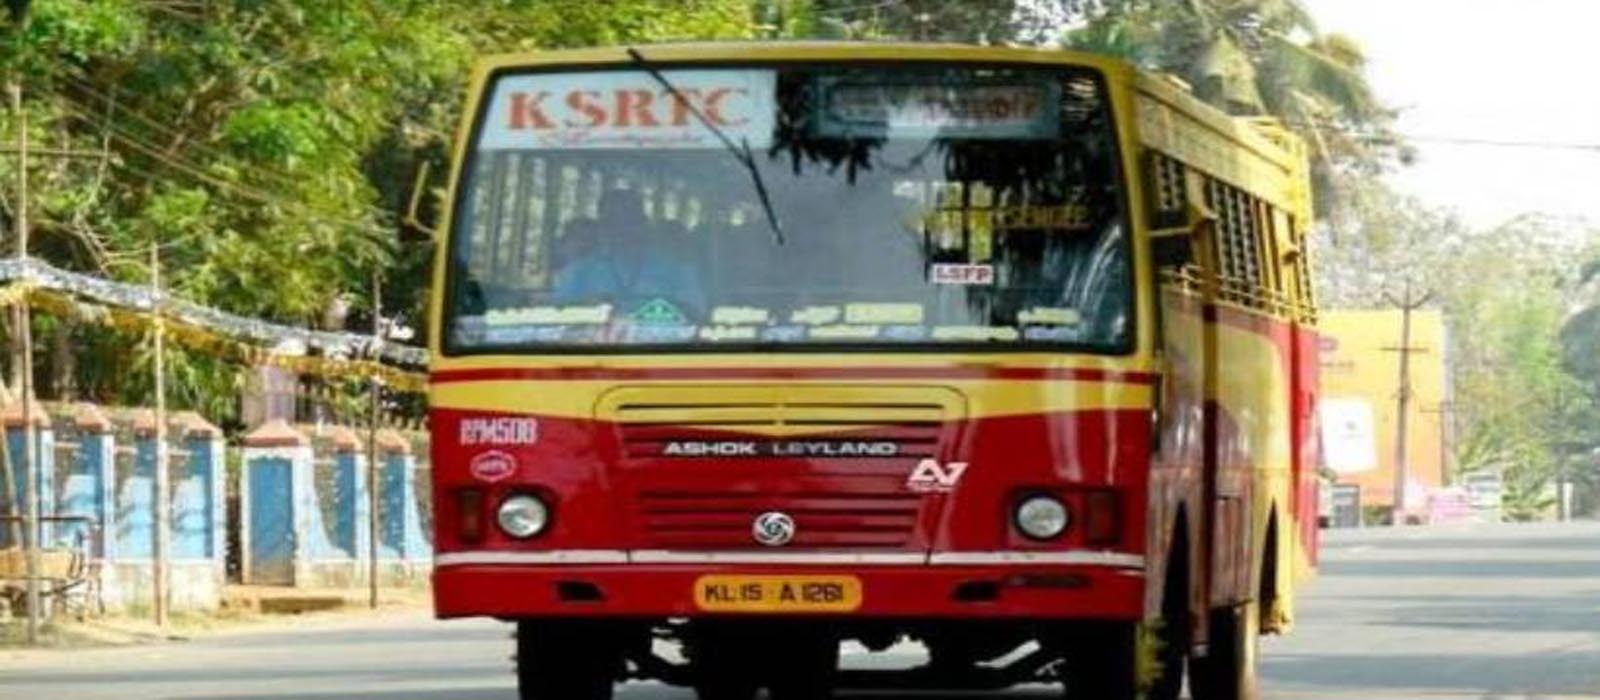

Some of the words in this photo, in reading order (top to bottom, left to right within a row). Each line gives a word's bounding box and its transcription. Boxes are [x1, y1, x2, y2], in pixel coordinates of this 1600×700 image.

[507, 85, 750, 131] KSRTC
[663, 441, 756, 456] ASHOK
[772, 441, 898, 456] LEYLAND
